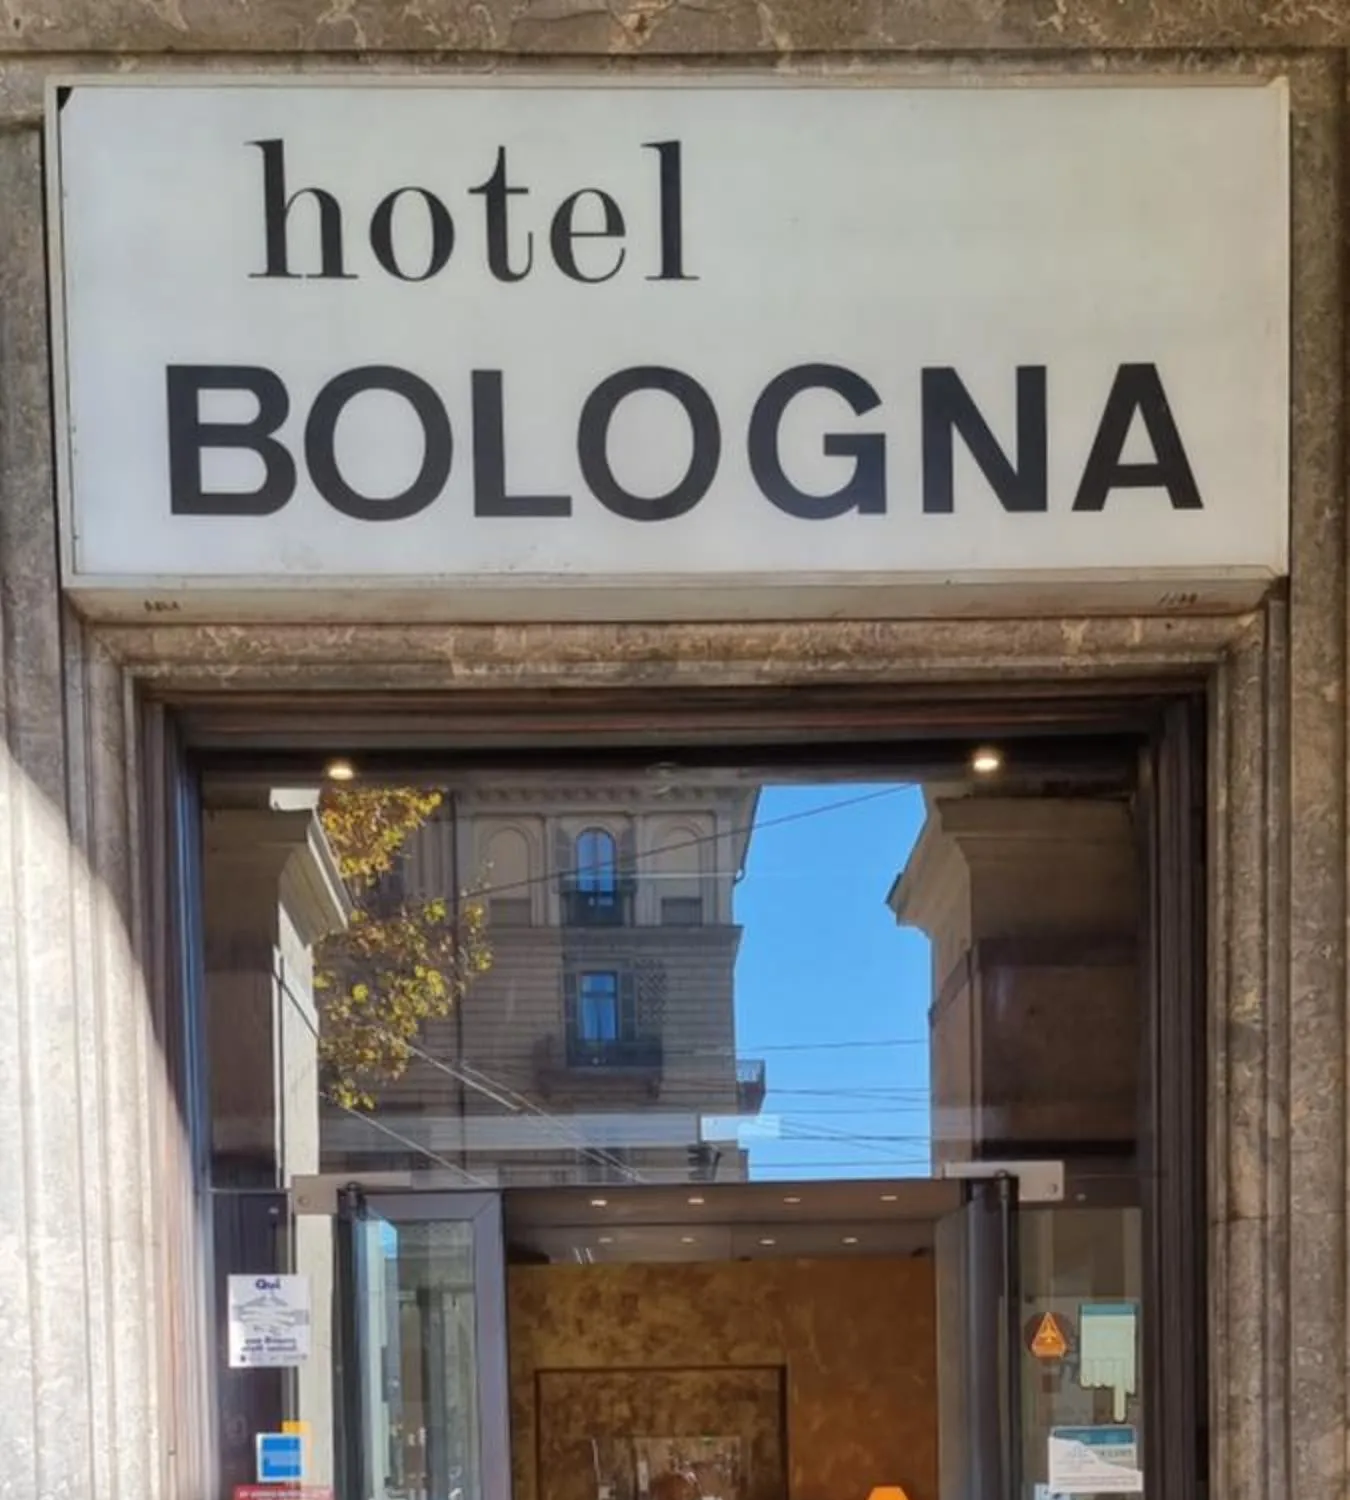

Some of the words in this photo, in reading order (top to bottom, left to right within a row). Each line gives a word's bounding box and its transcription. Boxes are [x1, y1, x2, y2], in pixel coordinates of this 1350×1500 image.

[246, 138, 700, 284] hotel
[165, 362, 1204, 522] BOLOGNA
[254, 1277, 281, 1291] Qui
